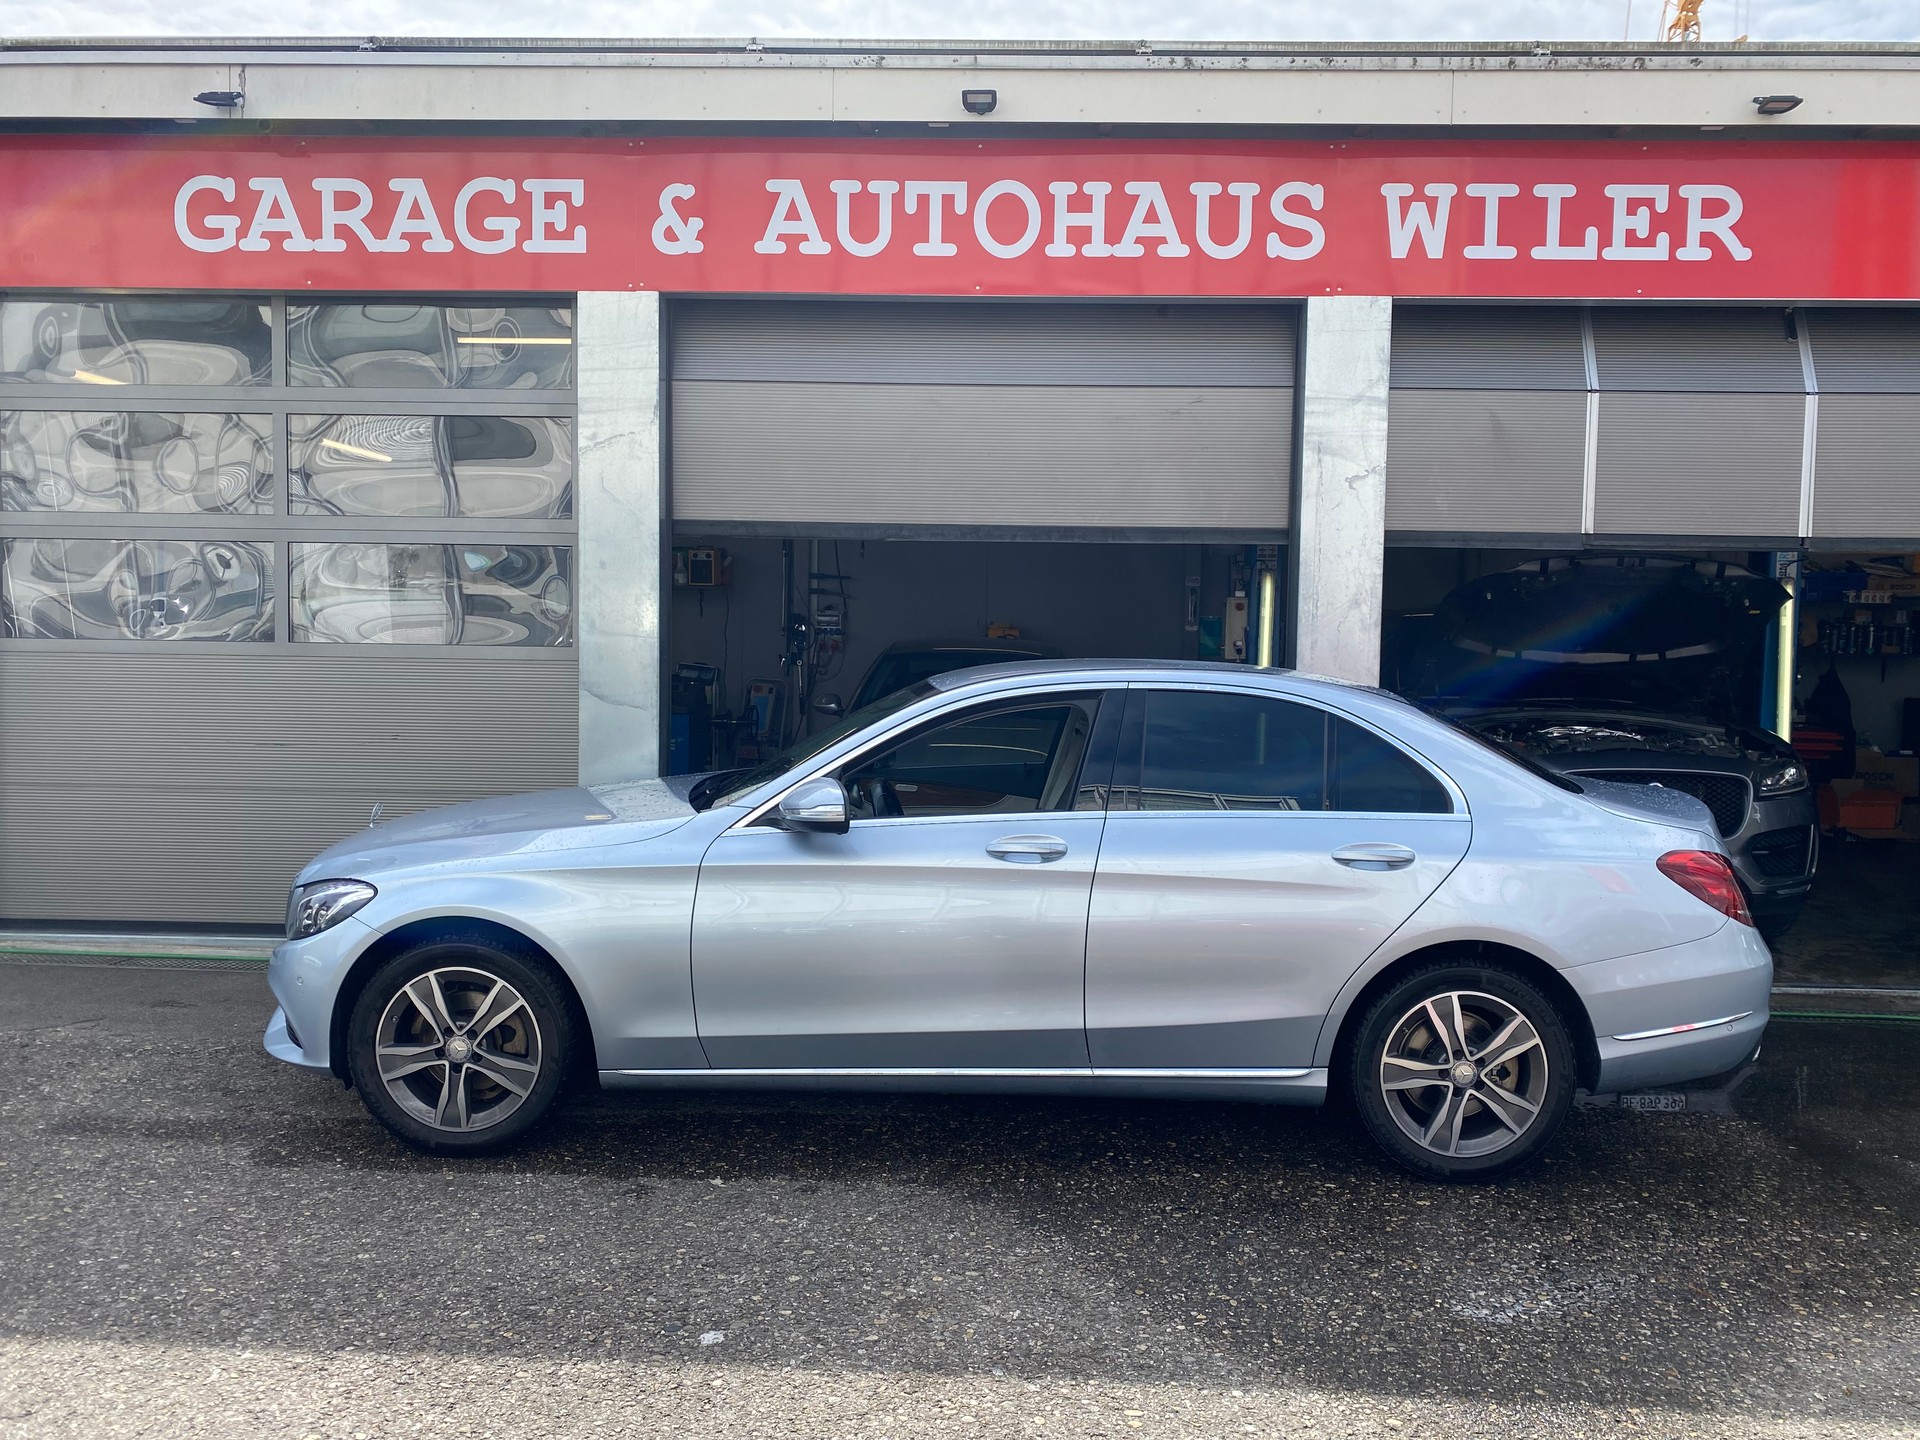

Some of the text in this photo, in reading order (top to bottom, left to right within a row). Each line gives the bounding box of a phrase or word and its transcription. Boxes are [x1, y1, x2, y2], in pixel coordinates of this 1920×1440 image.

[173, 175, 1753, 262] GARAGE & AUTOHAUS WILER
